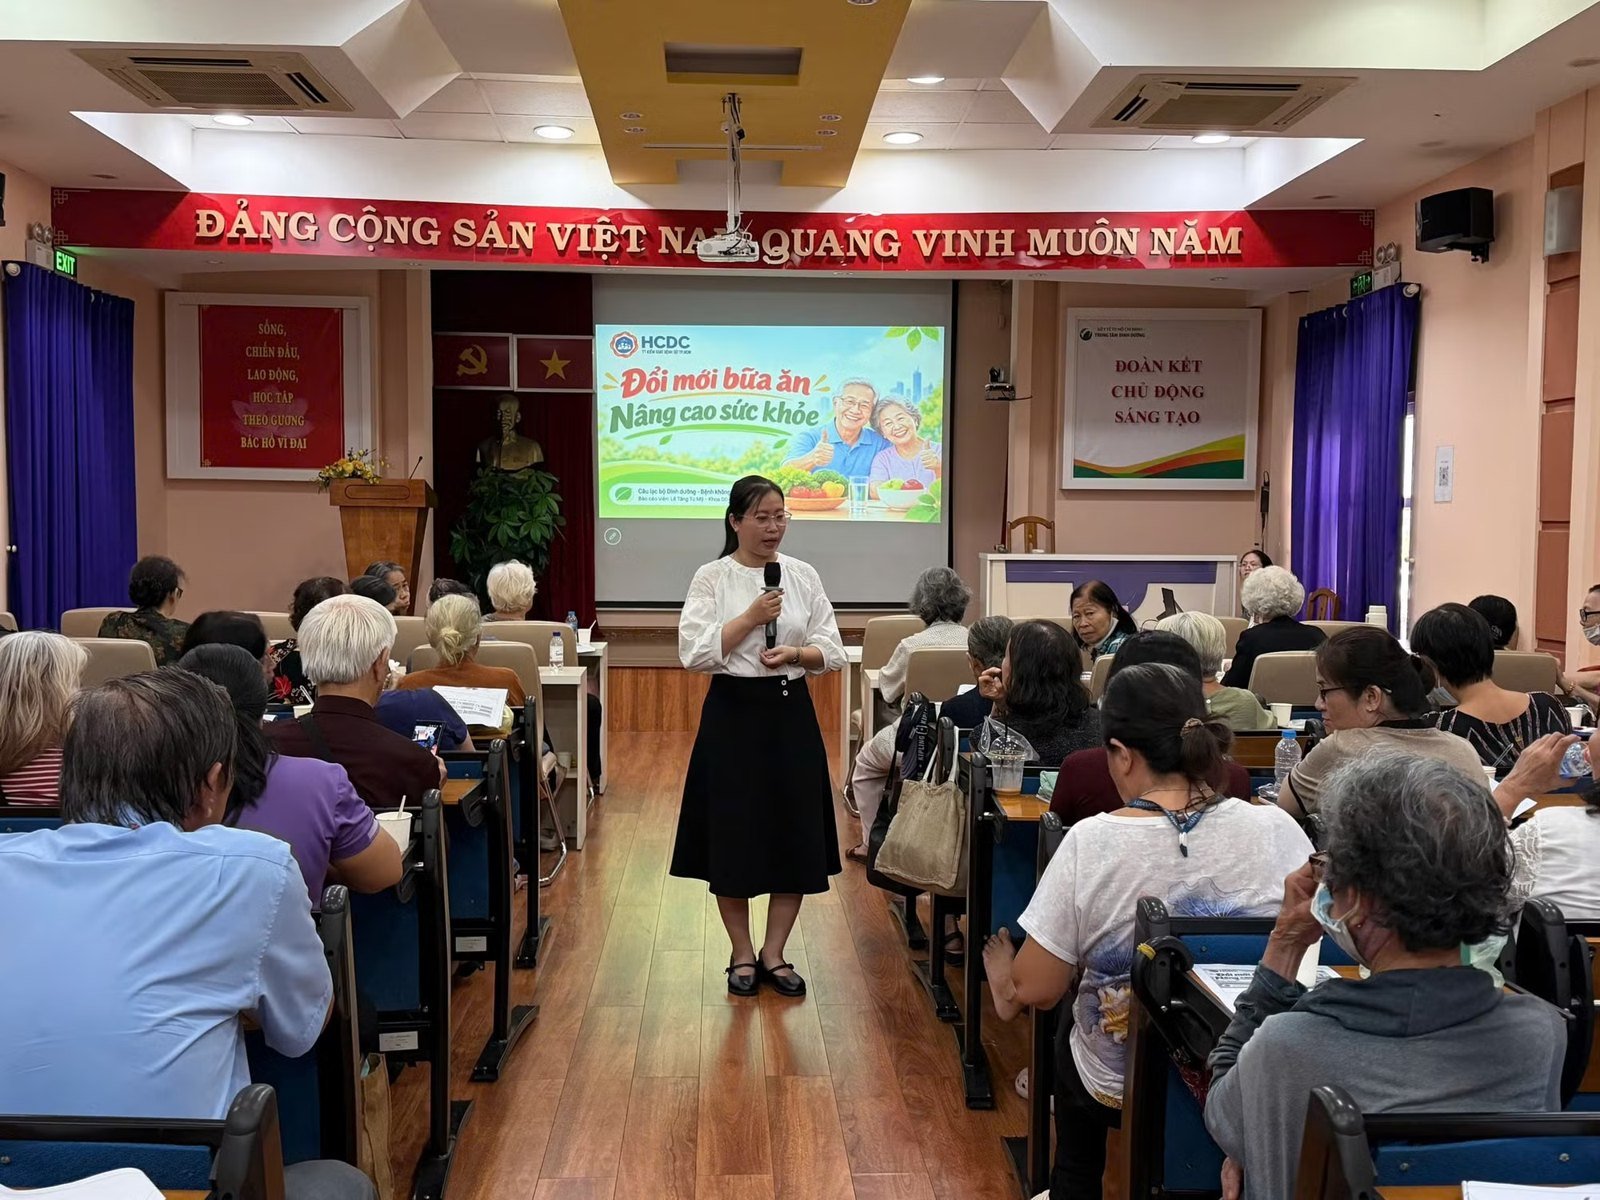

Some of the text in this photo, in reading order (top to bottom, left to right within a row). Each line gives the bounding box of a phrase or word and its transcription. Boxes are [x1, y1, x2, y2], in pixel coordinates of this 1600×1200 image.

[195, 198, 1242, 264] ĐẢNG CỘNG SẢN VIỆT NA QUANG VINH MUÔN NĂM
[56, 251, 76, 275] EXIT
[641, 336, 691, 349] HCDC
[1115, 355, 1203, 373] ĐOÀN KẾT
[247, 369, 266, 380] LAO
[620, 366, 811, 399] Đổi mới bữa ăn
[1111, 381, 1205, 401] CHỦ ĐỘNG
[243, 414, 269, 426] THEO
[609, 399, 819, 434] Nâng cao sức khỏe
[1115, 406, 1200, 426] SÁNG TẠO
[241, 433, 260, 448] BÁC
[290, 438, 307, 452] ĐẠI
[917, 735, 926, 760] KIPLING
